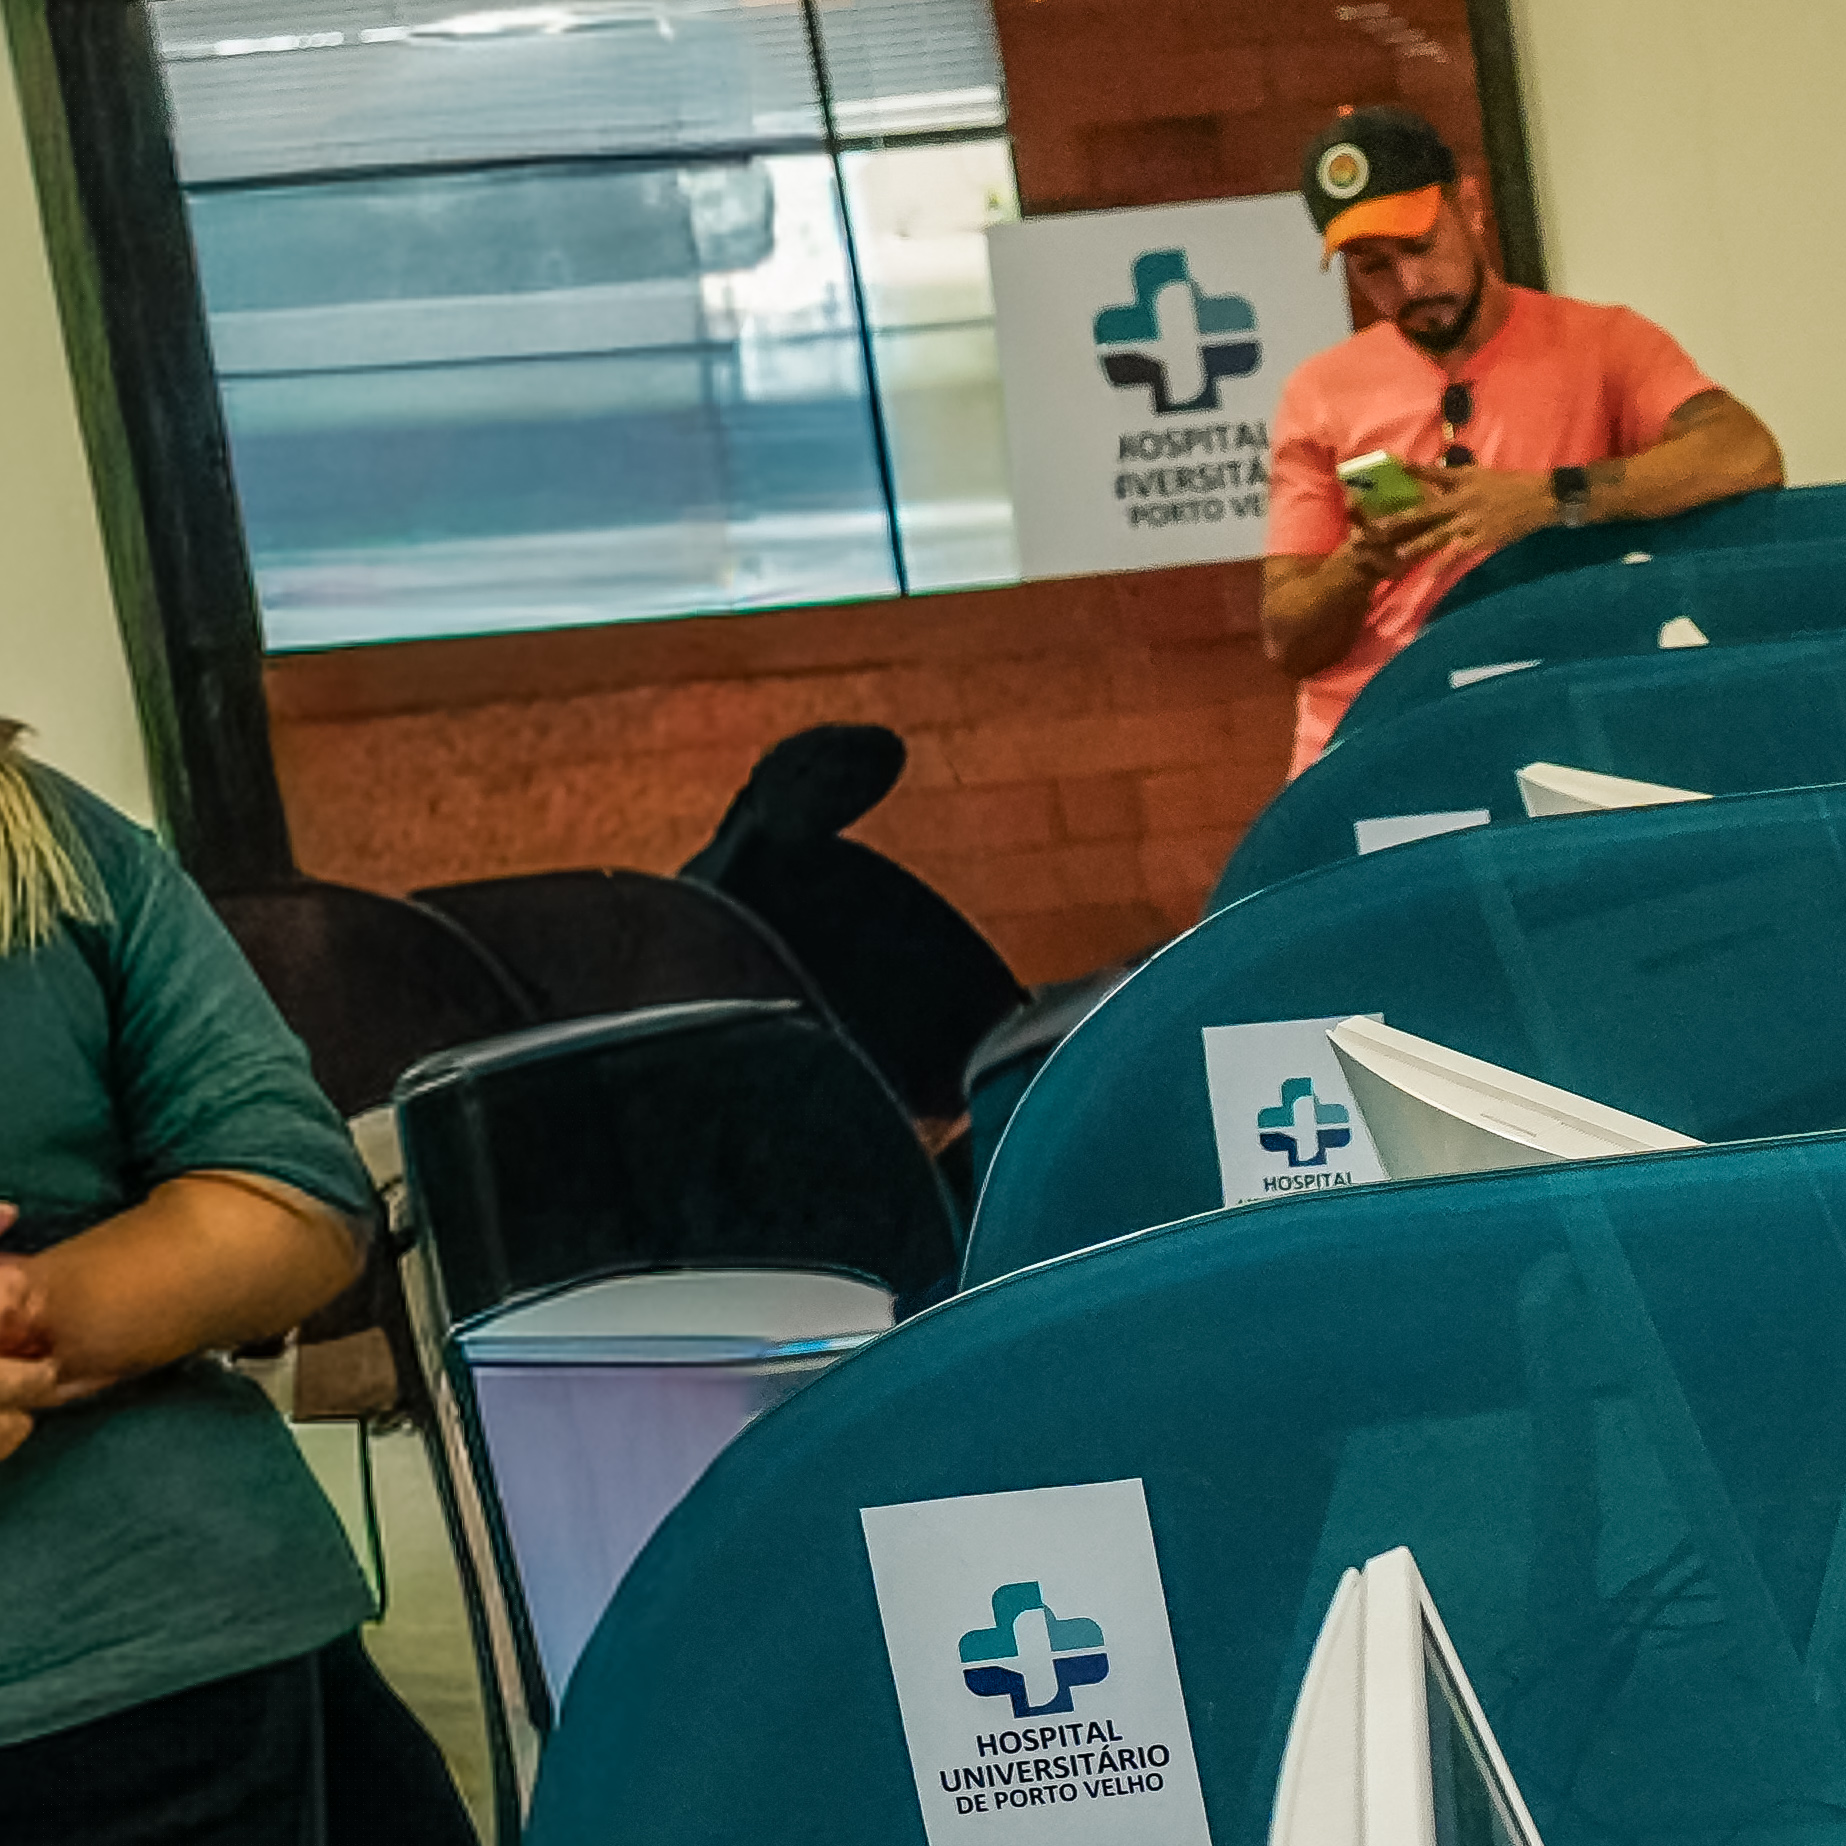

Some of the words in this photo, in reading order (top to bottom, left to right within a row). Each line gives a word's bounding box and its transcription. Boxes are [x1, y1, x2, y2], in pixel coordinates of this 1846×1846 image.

[976, 1719, 1123, 1758] HOSPITAL
[940, 1744, 1170, 1792] UNIVERSITÁRIO
[956, 1793, 989, 1815] DE
[994, 1783, 1078, 1810] PORTO
[1083, 1772, 1164, 1798] VELHO
